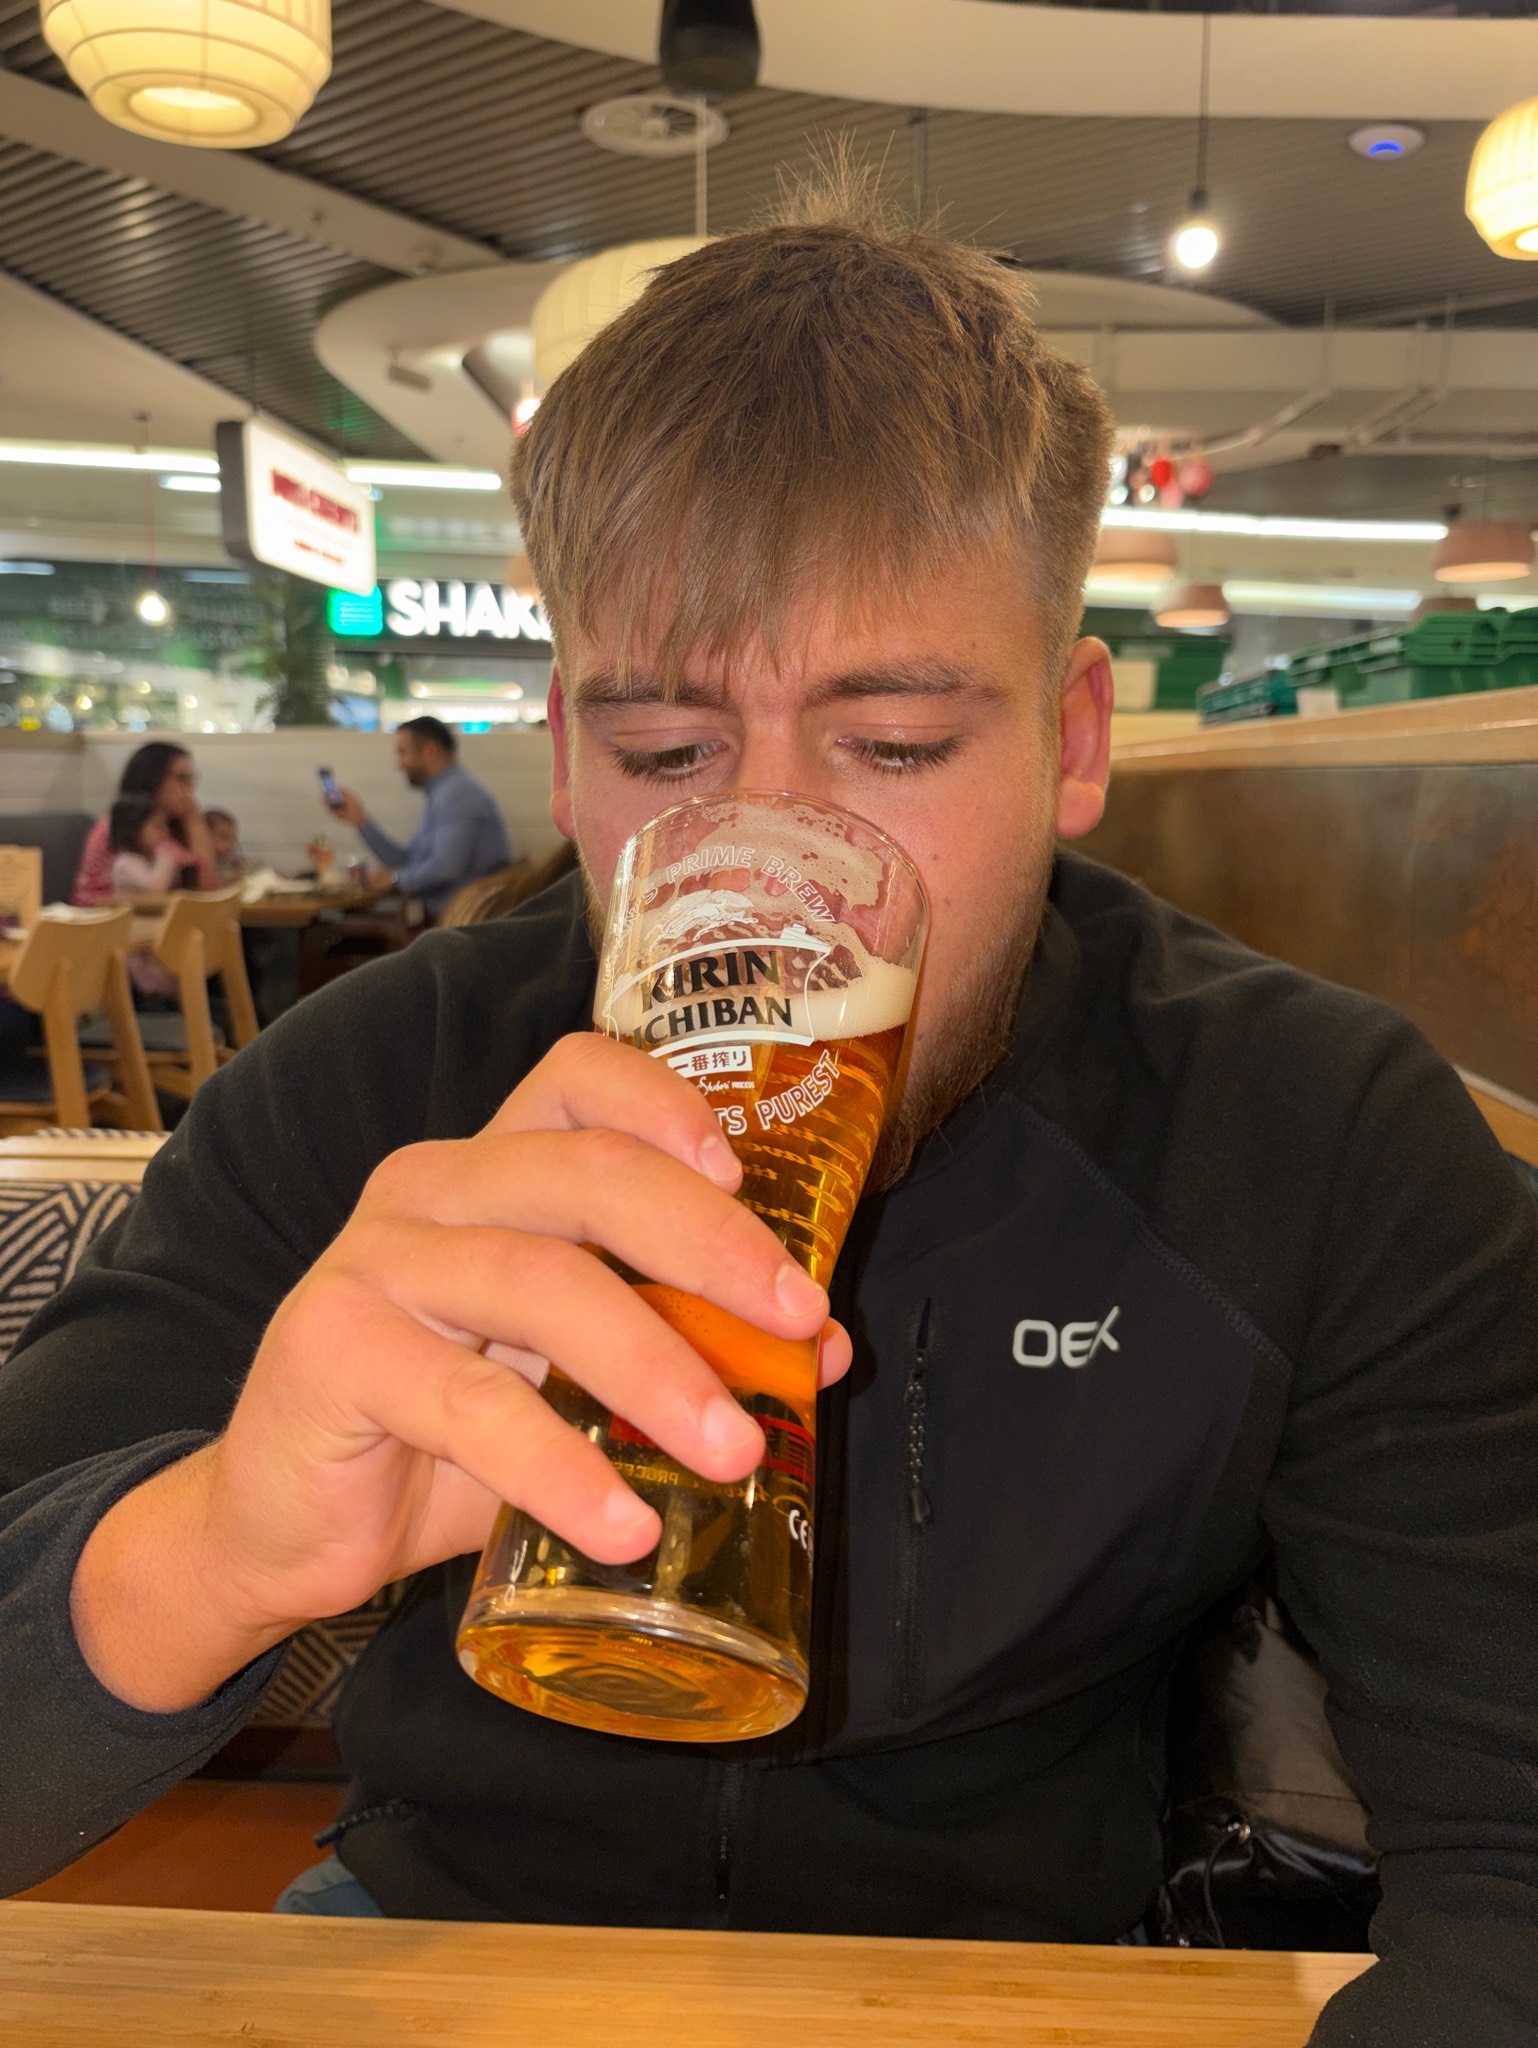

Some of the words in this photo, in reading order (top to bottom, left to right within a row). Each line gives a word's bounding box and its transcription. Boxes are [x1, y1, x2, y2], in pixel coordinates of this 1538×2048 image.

[387, 577, 552, 641] SHAK
[666, 846, 755, 884] PRIME
[761, 855, 836, 922] BREW
[641, 950, 780, 1014] KIRIN
[633, 996, 792, 1050] ICHIBAN
[673, 1051, 747, 1072] 一番搾り
[754, 1048, 840, 1131] PUREST
[1012, 1305, 1121, 1369] OEX
